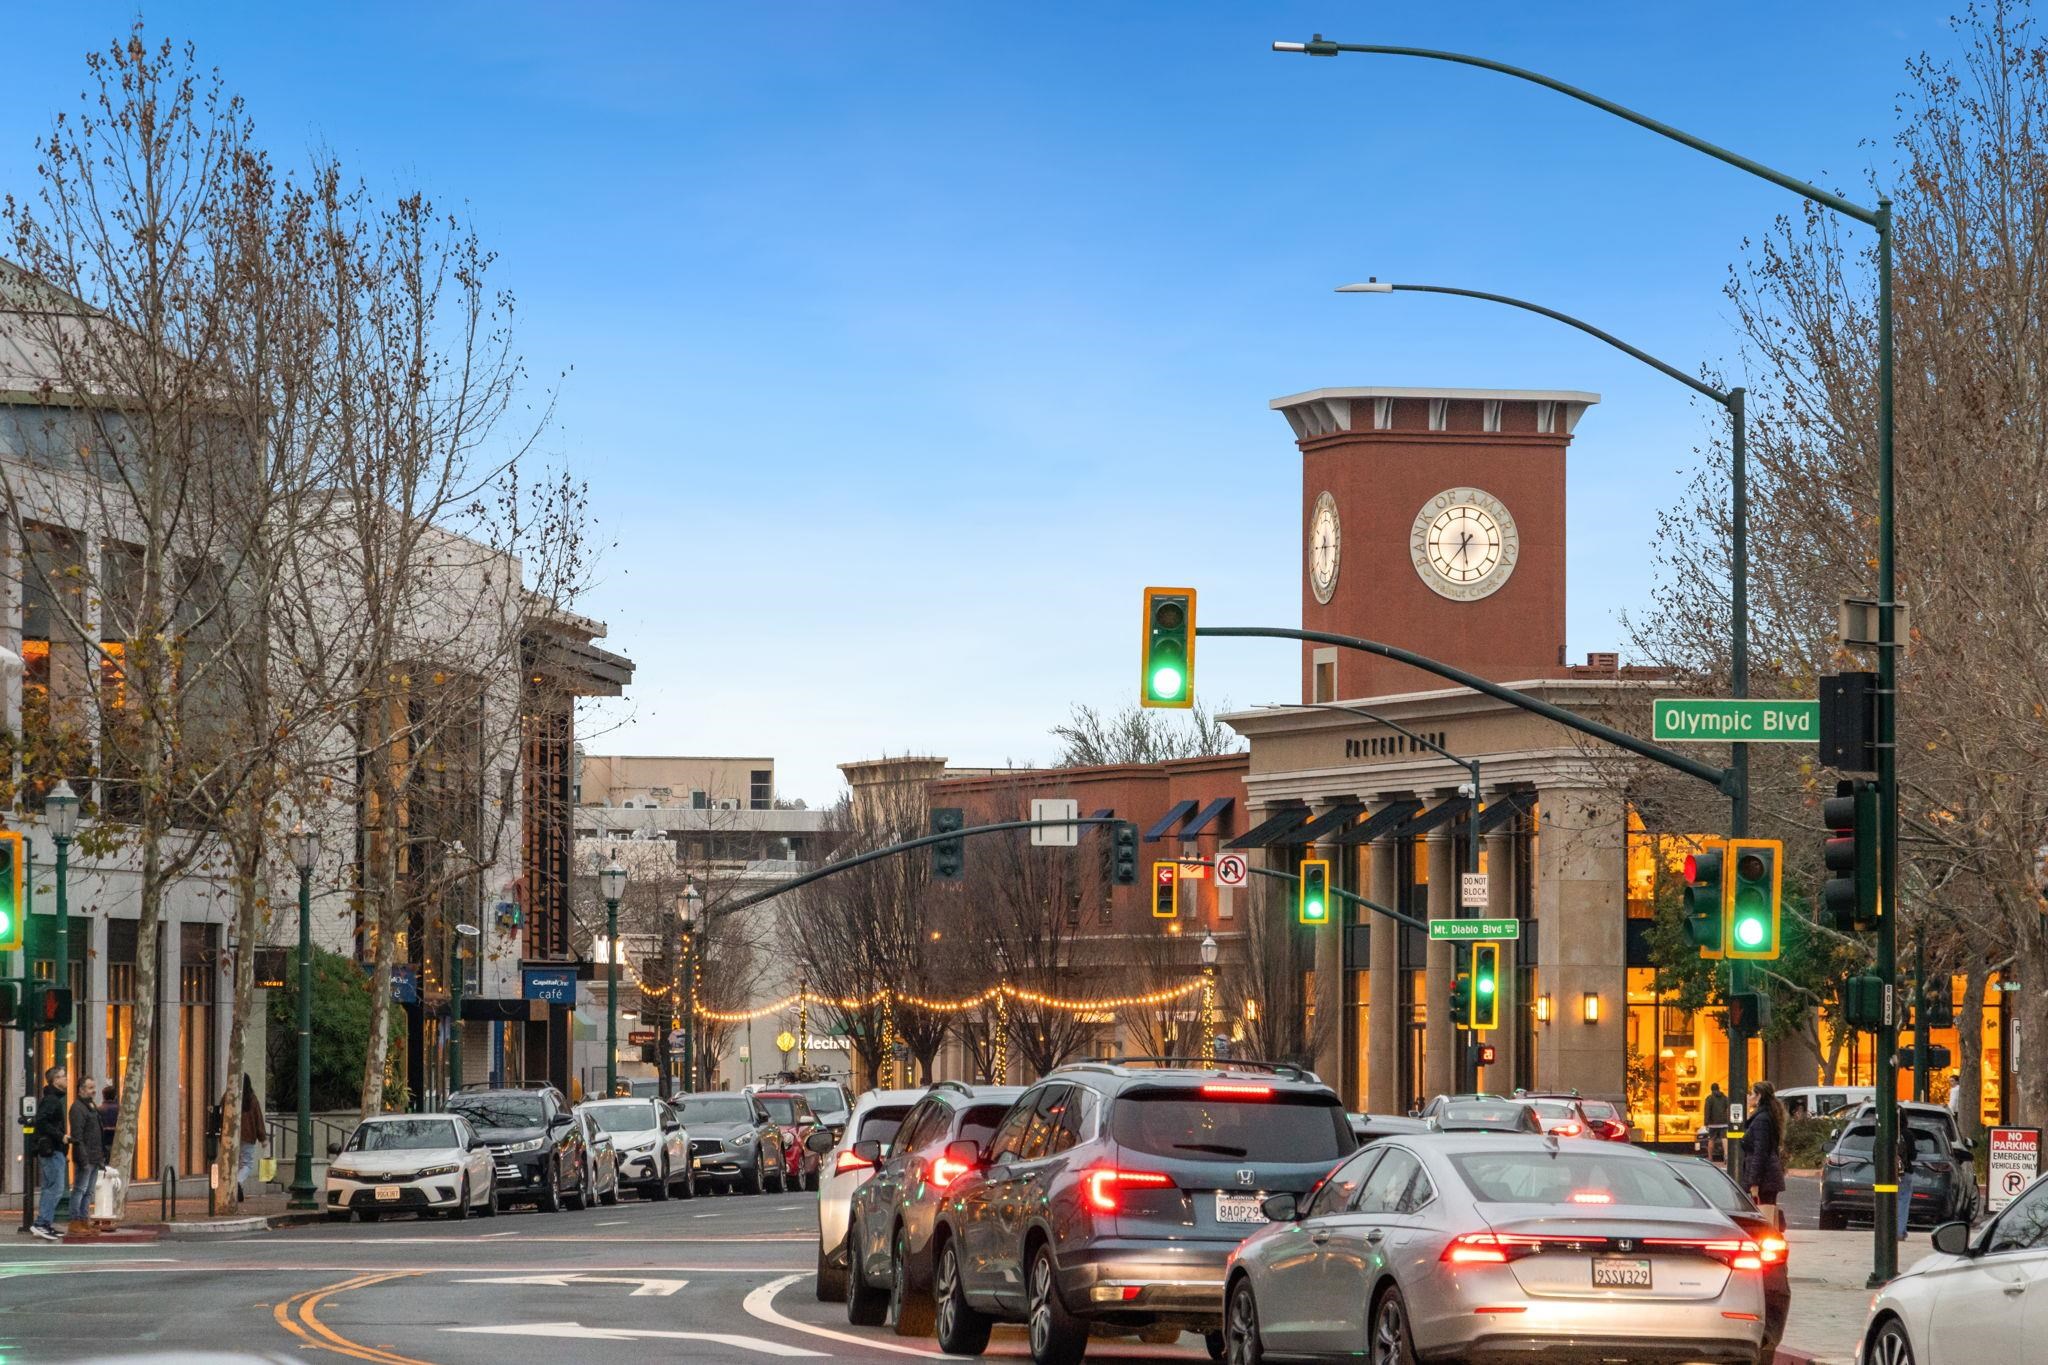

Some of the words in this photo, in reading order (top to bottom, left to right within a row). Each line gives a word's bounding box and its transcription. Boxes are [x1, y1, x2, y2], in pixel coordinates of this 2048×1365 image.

[1413, 512, 1433, 568] BANK
[1435, 491, 1456, 510] OF
[1465, 490, 1516, 567] AMERICA
[1665, 709, 1753, 735] Olympic
[1763, 710, 1810, 732] Blvd
[1464, 877, 1473, 886] DO
[1474, 877, 1487, 886] NOT
[1464, 888, 1487, 896] BLOCK
[1434, 925, 1448, 935] Mt.
[1451, 925, 1479, 934] Diablo
[1482, 924, 1502, 934] Blvd
[539, 988, 563, 1000] café
[2007, 1132, 2023, 1141] NO
[1993, 1141, 2037, 1150] PARKING
[1993, 1152, 2037, 1161] EMERGENCY
[1991, 1162, 2021, 1170] VEHICLES
[2021, 1162, 2038, 1170] ONLY
[1597, 1269, 1648, 1285] 9SSV329
